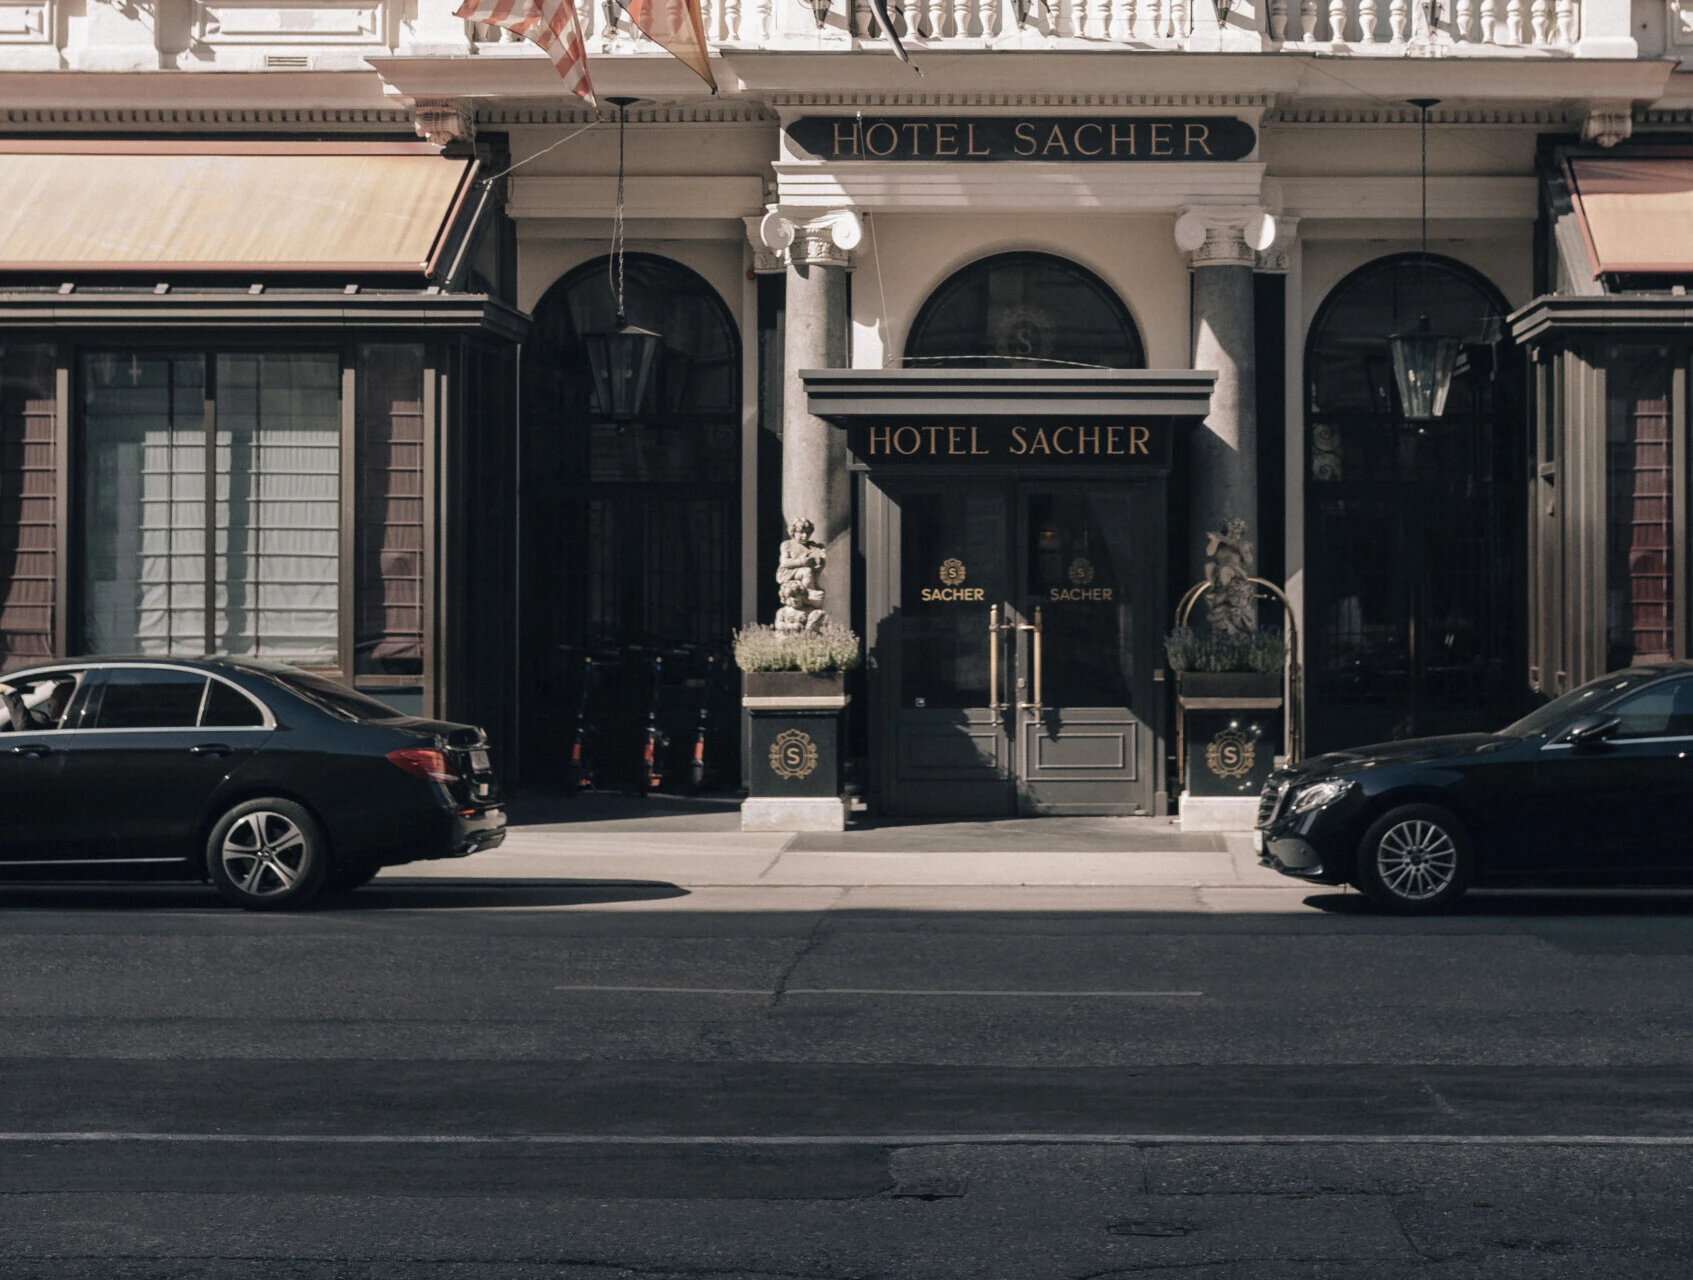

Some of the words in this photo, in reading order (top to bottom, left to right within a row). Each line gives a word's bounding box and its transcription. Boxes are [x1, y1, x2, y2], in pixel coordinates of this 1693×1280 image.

[832, 122, 990, 156] HOTEL
[1014, 122, 1213, 156] SACHER
[869, 426, 989, 455] HOTEL
[1009, 426, 1150, 455] SACHER
[921, 587, 985, 601] SACHER
[1050, 587, 1113, 601] SACHER
[786, 747, 801, 765] S
[1223, 746, 1238, 764] S
